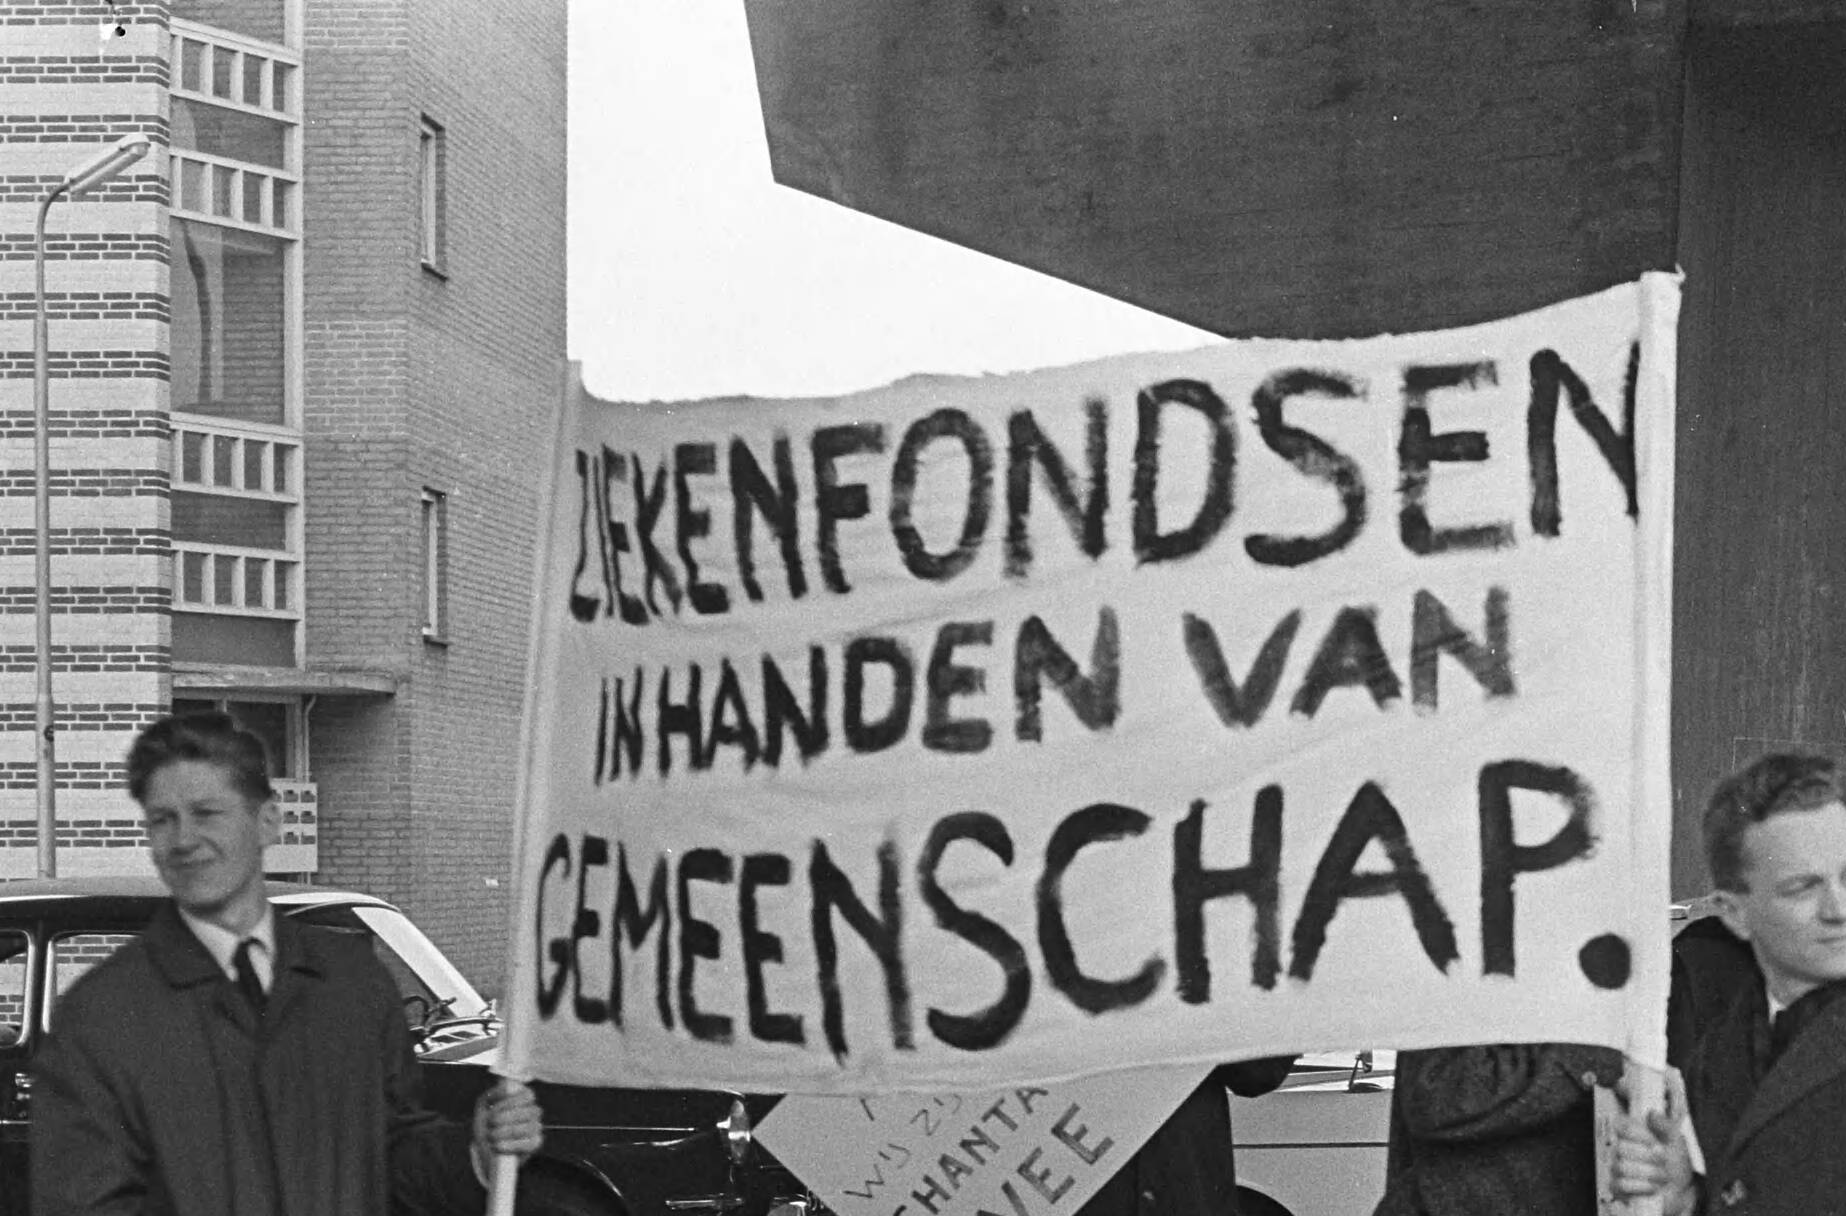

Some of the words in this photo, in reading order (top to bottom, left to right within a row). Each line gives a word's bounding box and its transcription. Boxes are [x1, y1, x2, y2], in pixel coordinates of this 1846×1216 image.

[567, 339, 1640, 625] ZIEKENFONDSEN
[656, 606, 1121, 775] HANDEN
[1182, 585, 1517, 728] VAN
[536, 759, 1632, 1064] GEMEENSCHAP.
